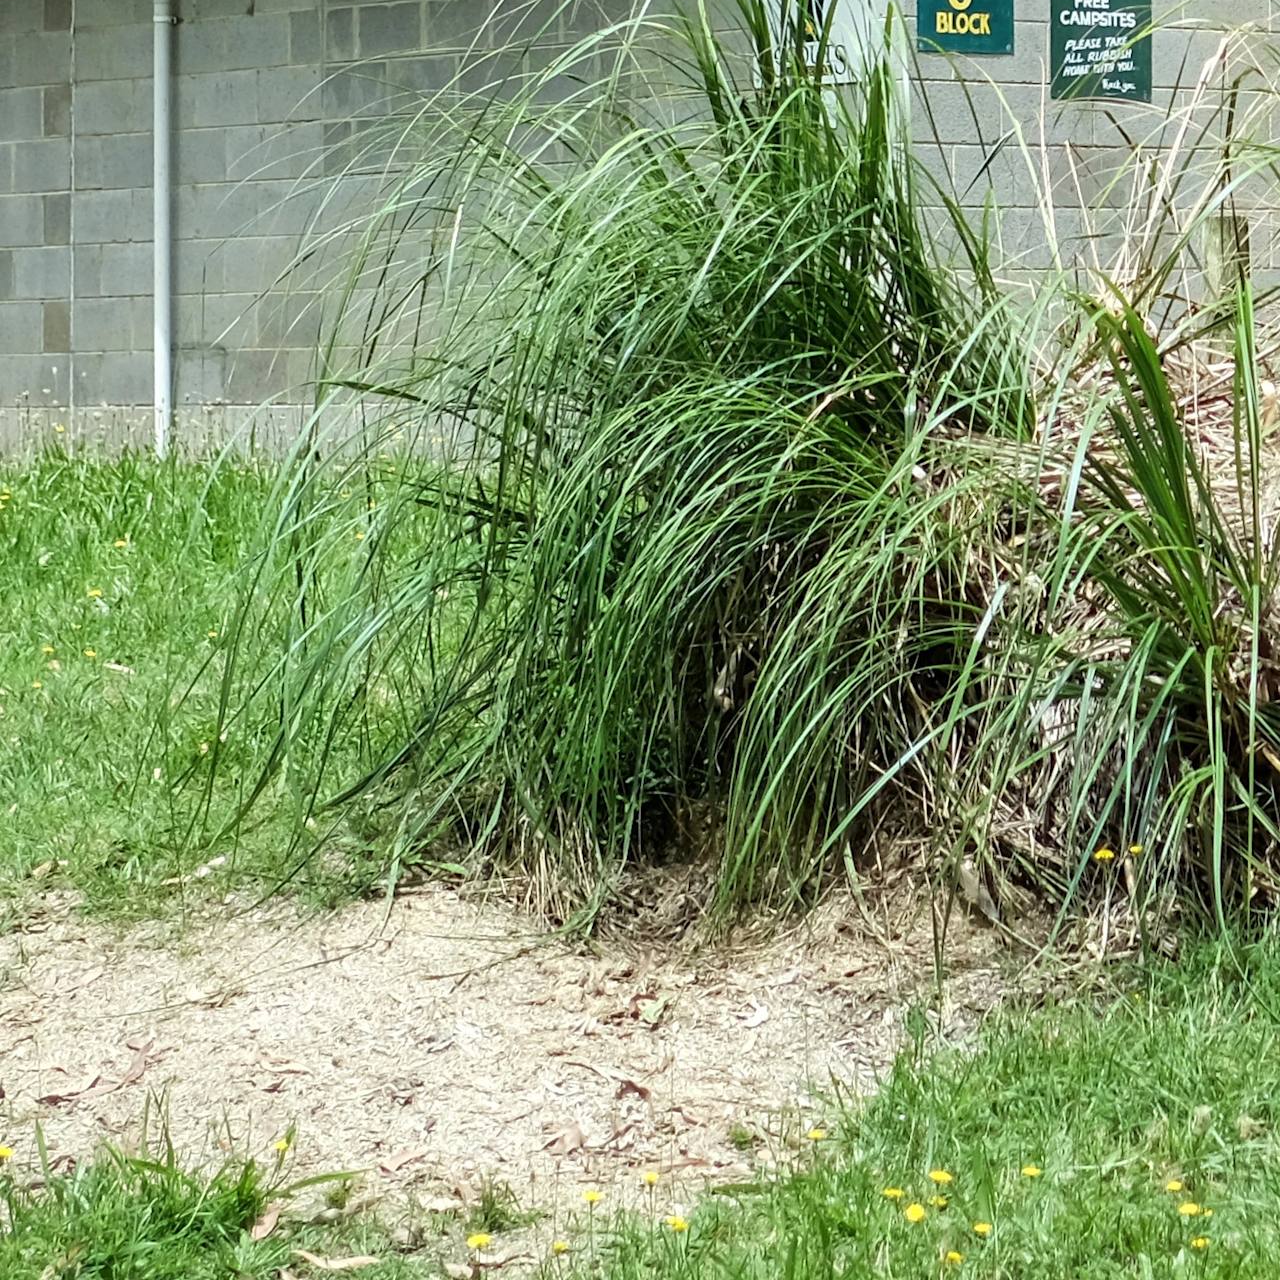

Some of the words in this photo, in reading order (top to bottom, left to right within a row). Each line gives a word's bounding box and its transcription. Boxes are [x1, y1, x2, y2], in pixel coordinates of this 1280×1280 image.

[936, 11, 991, 35] BLOCK
[1060, 10, 1137, 28] CAMPSITES
[1064, 38, 1102, 51] PLEASE
[1064, 52, 1085, 63] ALL
